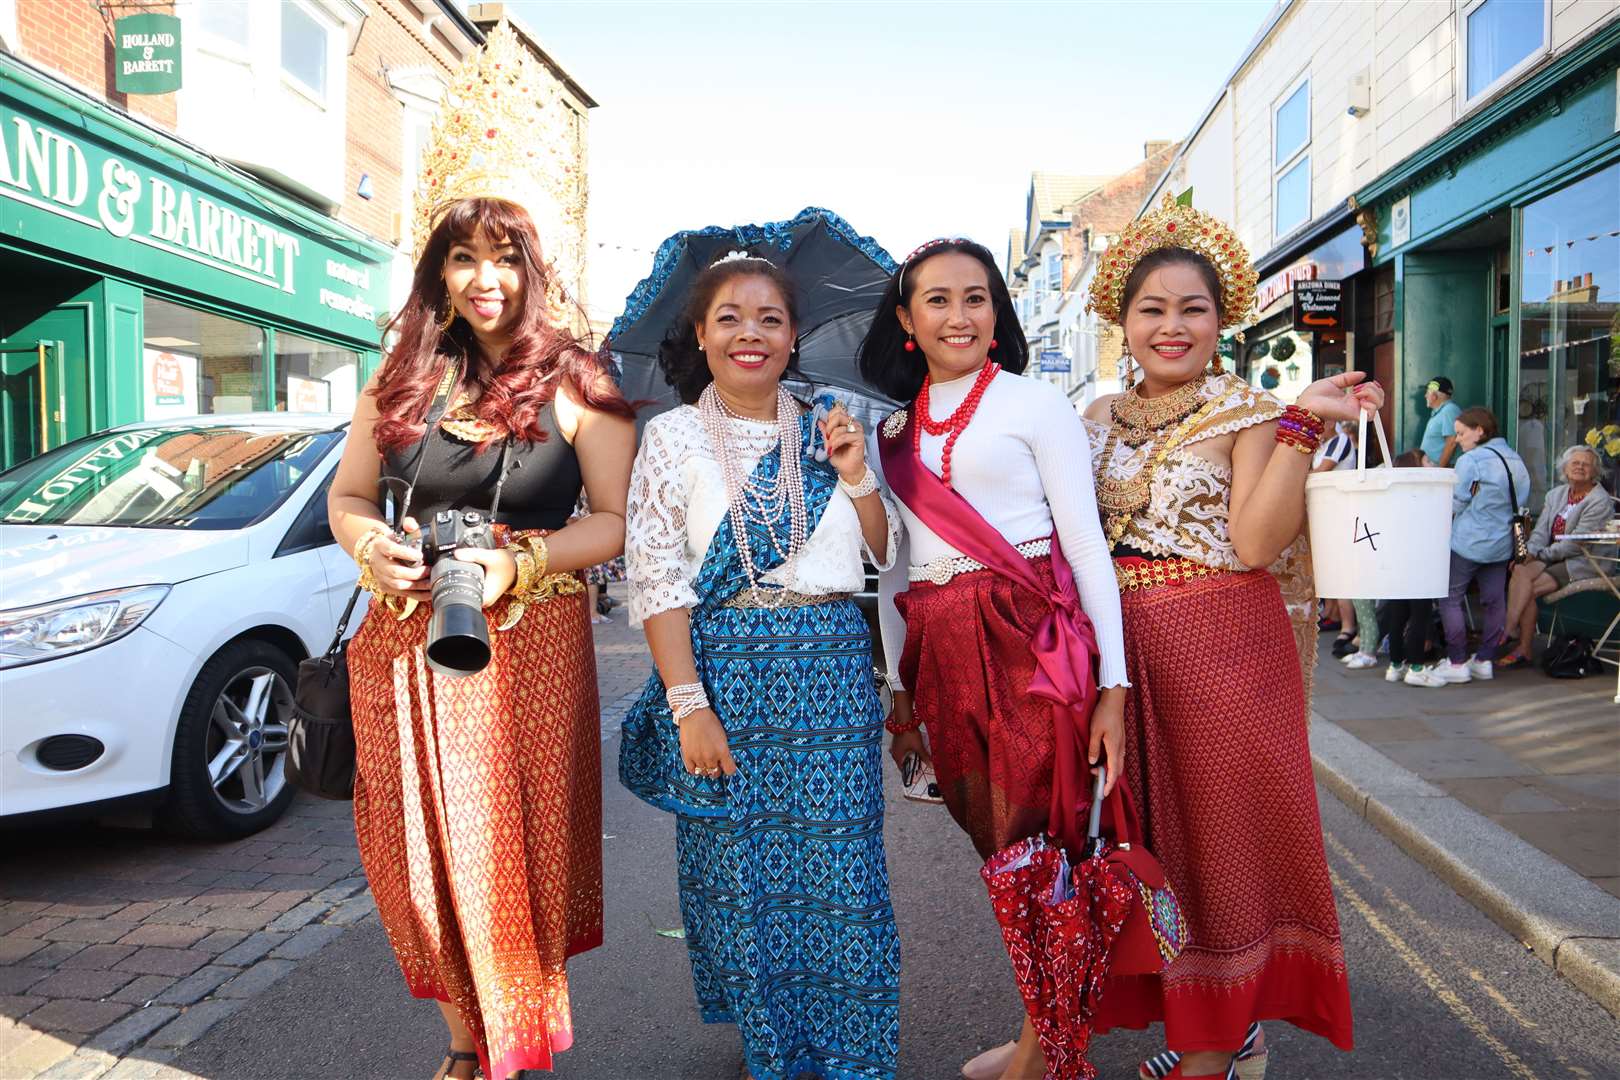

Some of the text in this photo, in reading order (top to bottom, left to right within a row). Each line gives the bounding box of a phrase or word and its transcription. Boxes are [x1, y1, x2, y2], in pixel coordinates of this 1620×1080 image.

[122, 33, 174, 48] HOLLAND
[143, 46, 155, 60] &
[122, 59, 174, 75] BARRETT
[98, 158, 142, 238] &
[149, 176, 301, 295] BARRETT
[1297, 281, 1341, 290] ARIZONA DINER
[1353, 516, 1381, 551] 4
